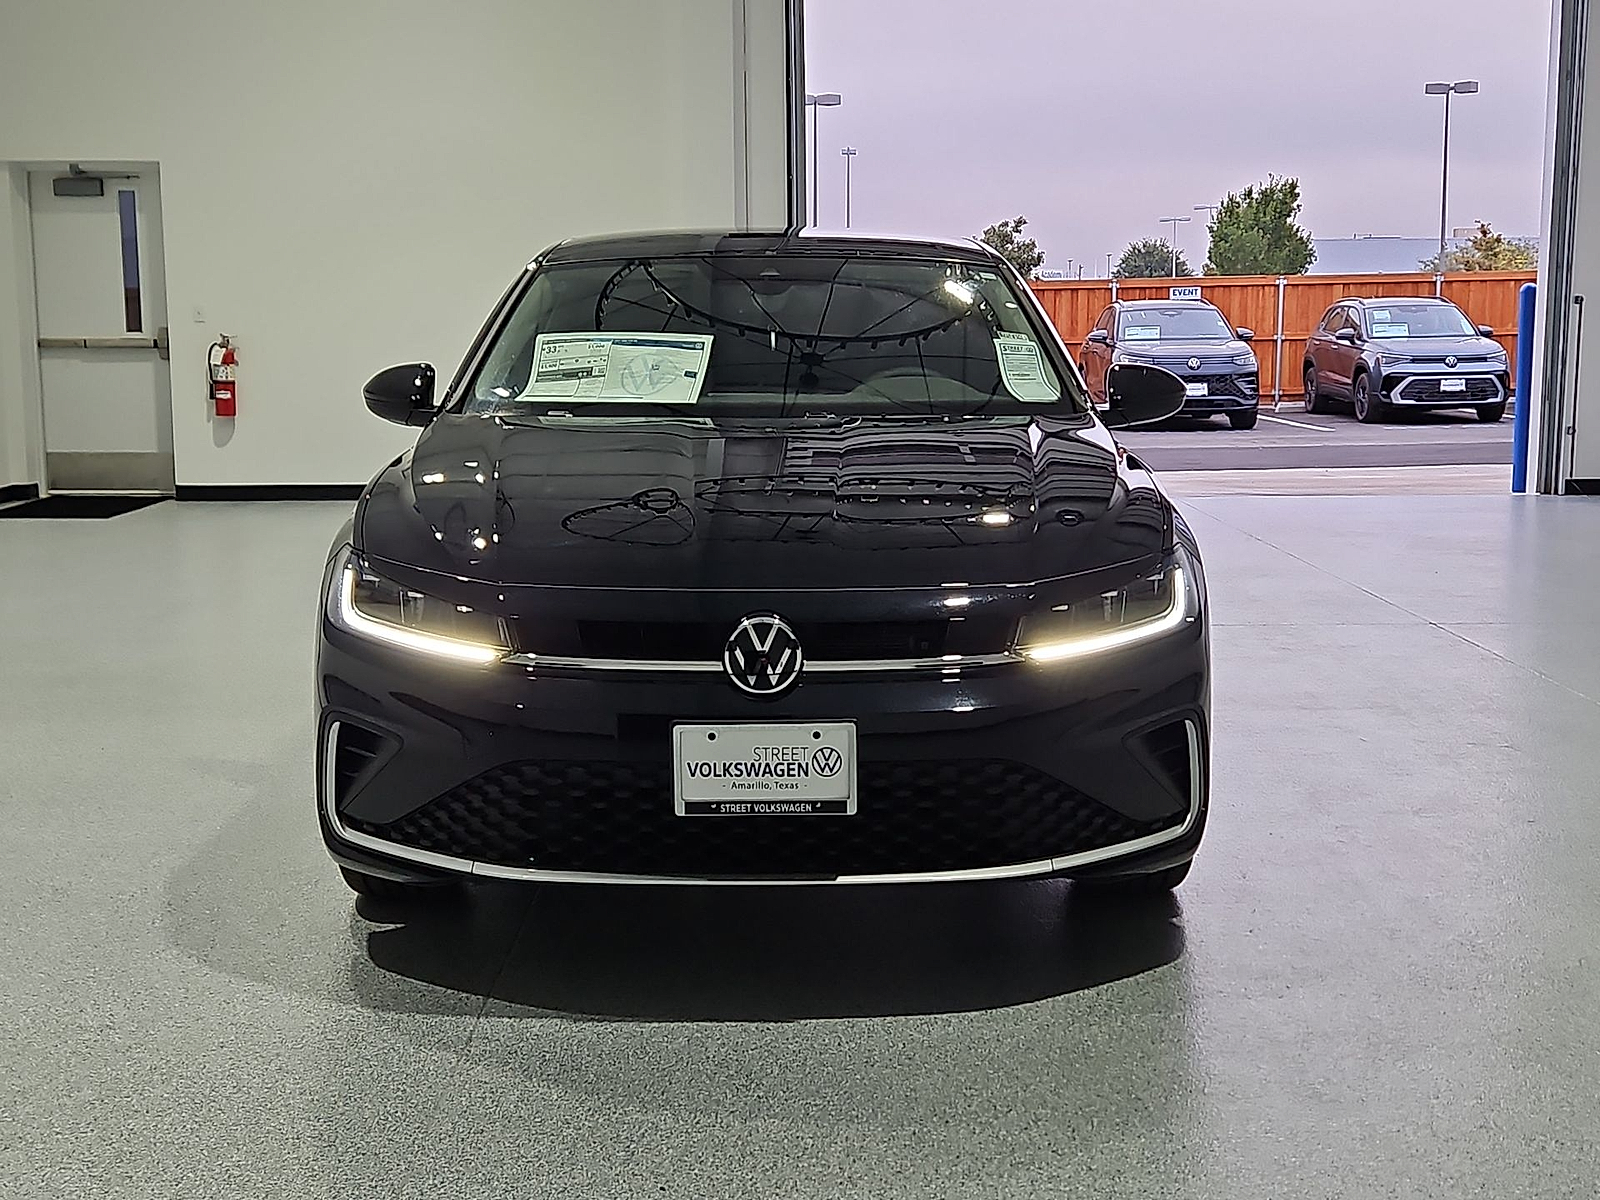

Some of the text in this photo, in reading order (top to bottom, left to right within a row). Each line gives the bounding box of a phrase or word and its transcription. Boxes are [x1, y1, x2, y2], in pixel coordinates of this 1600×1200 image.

[1172, 288, 1199, 296] EVENT
[753, 746, 809, 761] STREET
[686, 761, 809, 778] VOLKSWAGEN
[730, 781, 800, 791] Amarillo, Texas
[720, 803, 812, 813] STREET VOLKSWAGEN
